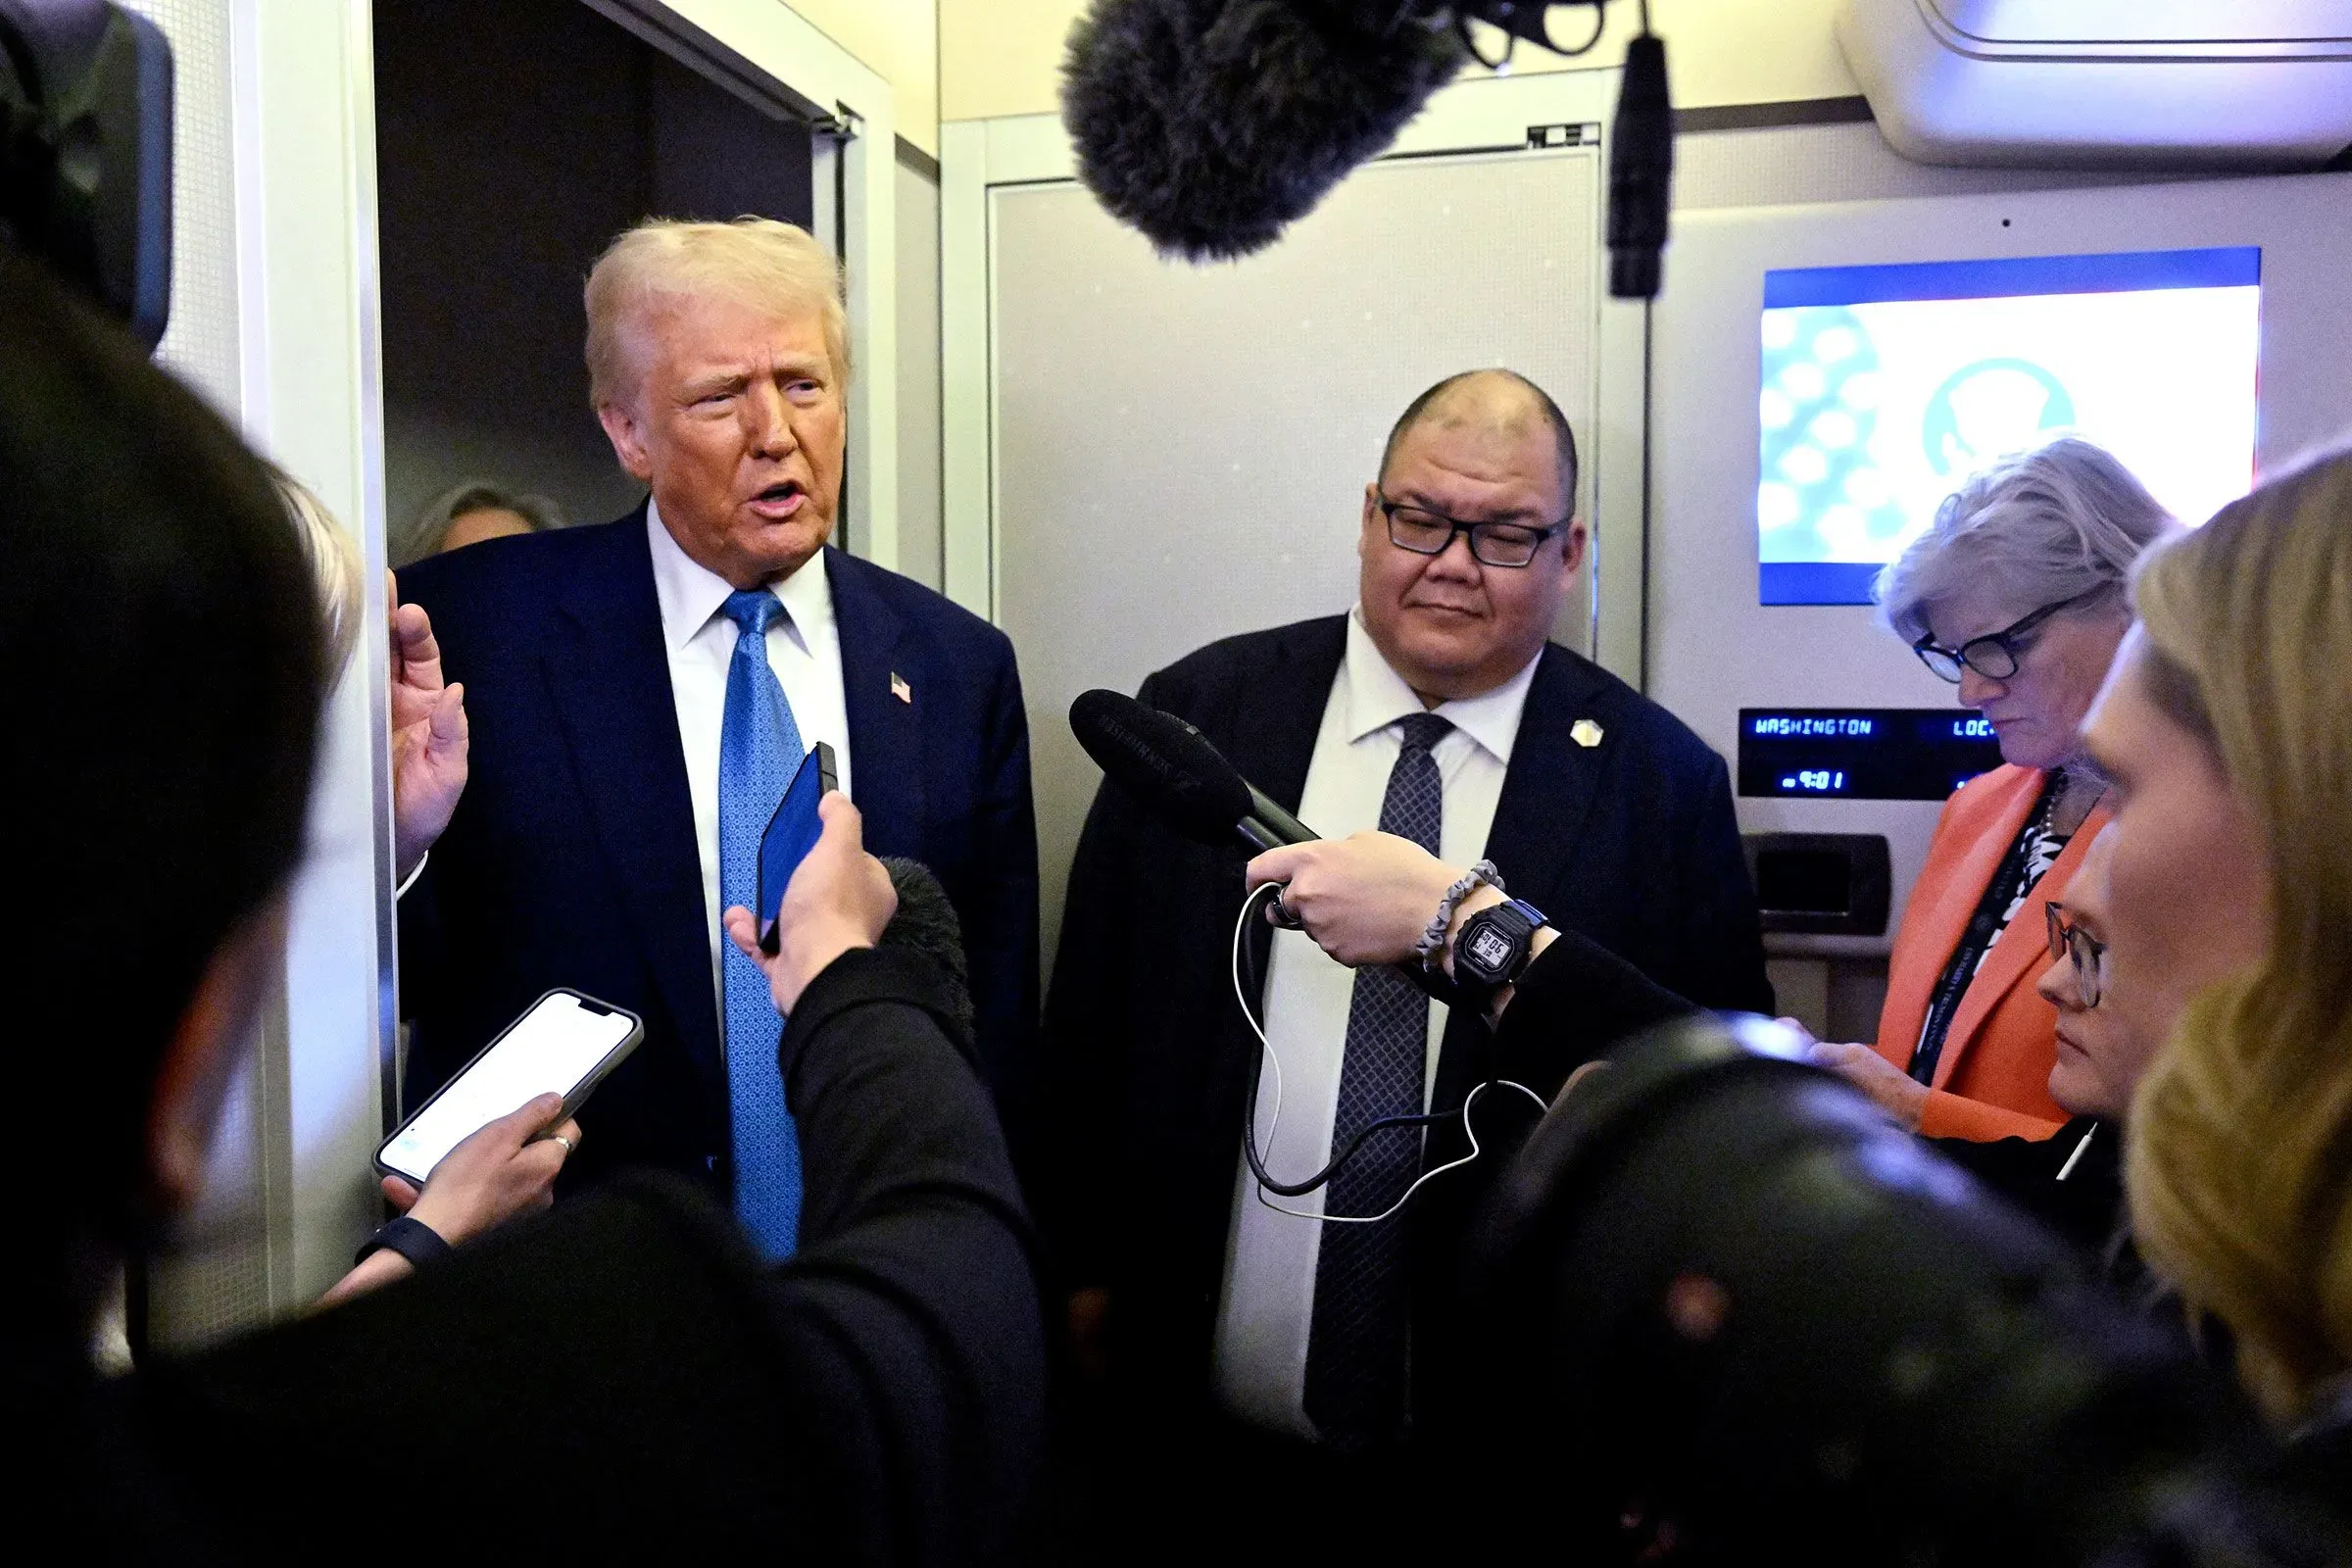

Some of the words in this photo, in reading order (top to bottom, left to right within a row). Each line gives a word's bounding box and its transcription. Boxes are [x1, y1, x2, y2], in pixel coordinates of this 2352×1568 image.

[1755, 717, 1872, 735] WASHINGTON
[1953, 719, 1995, 736] LOC
[1799, 770, 1843, 789] 9:01
